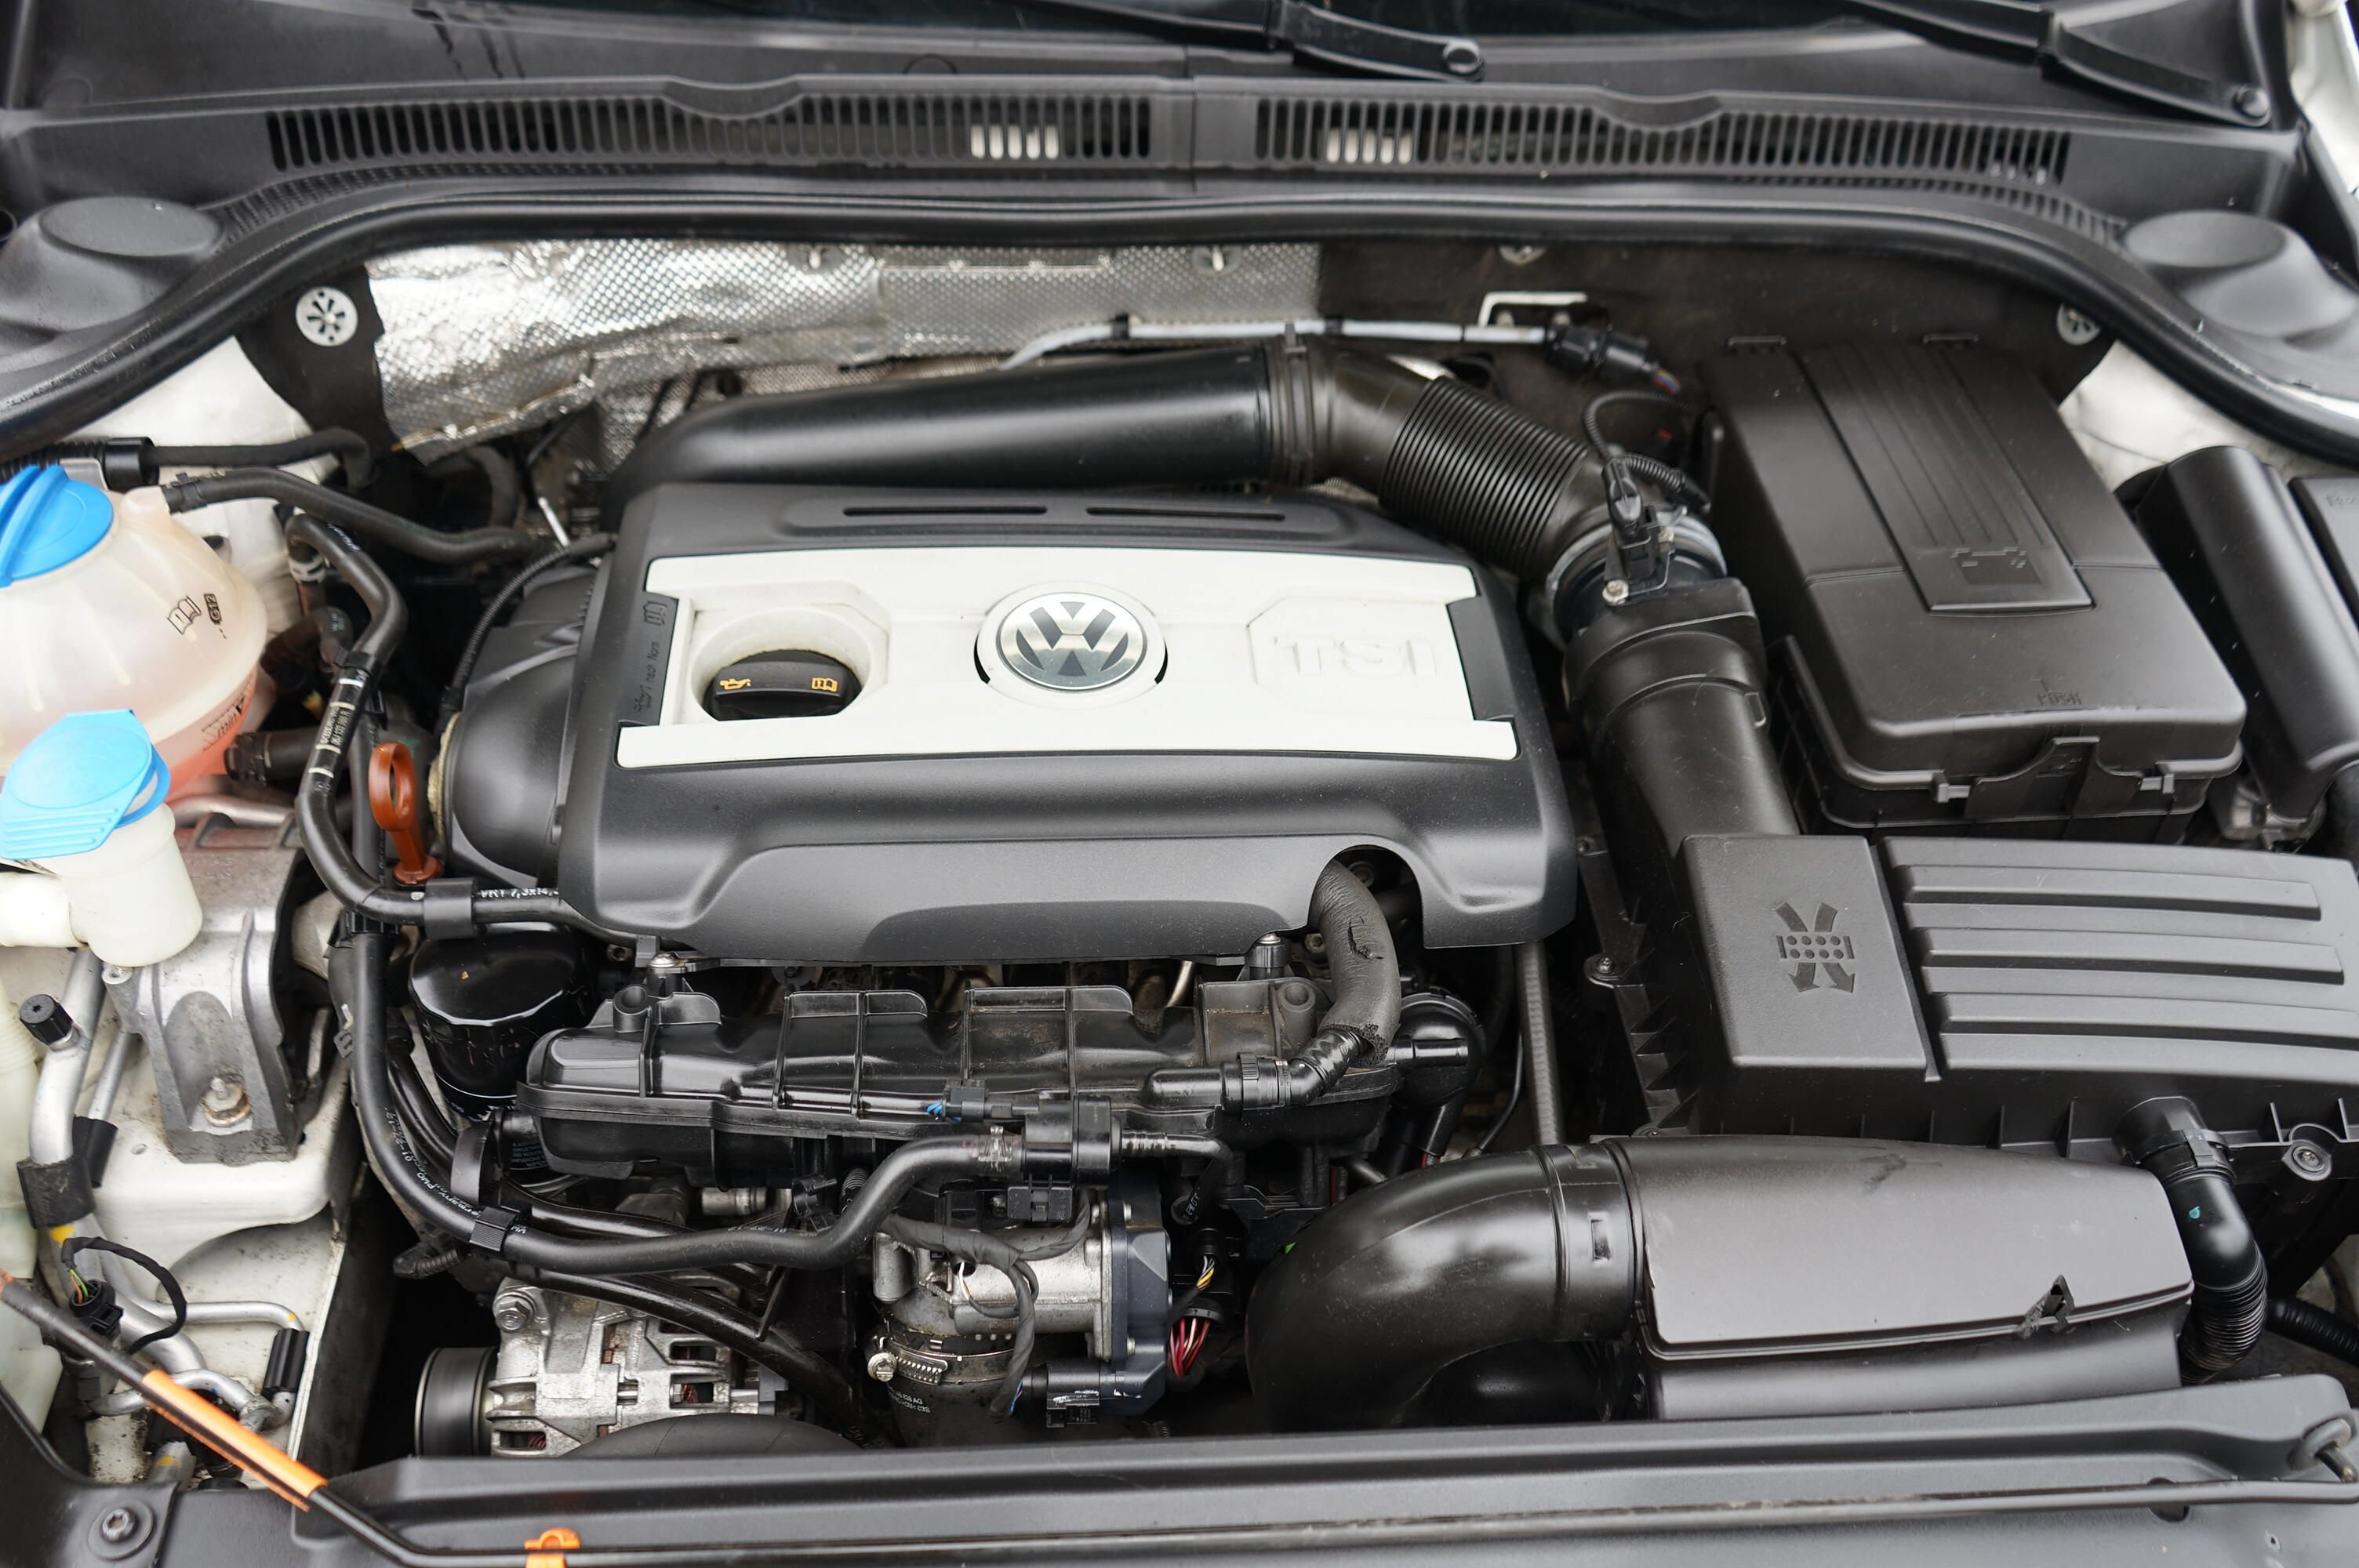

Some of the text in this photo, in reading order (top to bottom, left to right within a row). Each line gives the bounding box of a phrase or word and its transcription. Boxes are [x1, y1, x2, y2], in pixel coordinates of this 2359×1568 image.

[204, 593, 222, 624] G12
[1000, 593, 1145, 688] VW
[1272, 634, 1438, 677] TSI
